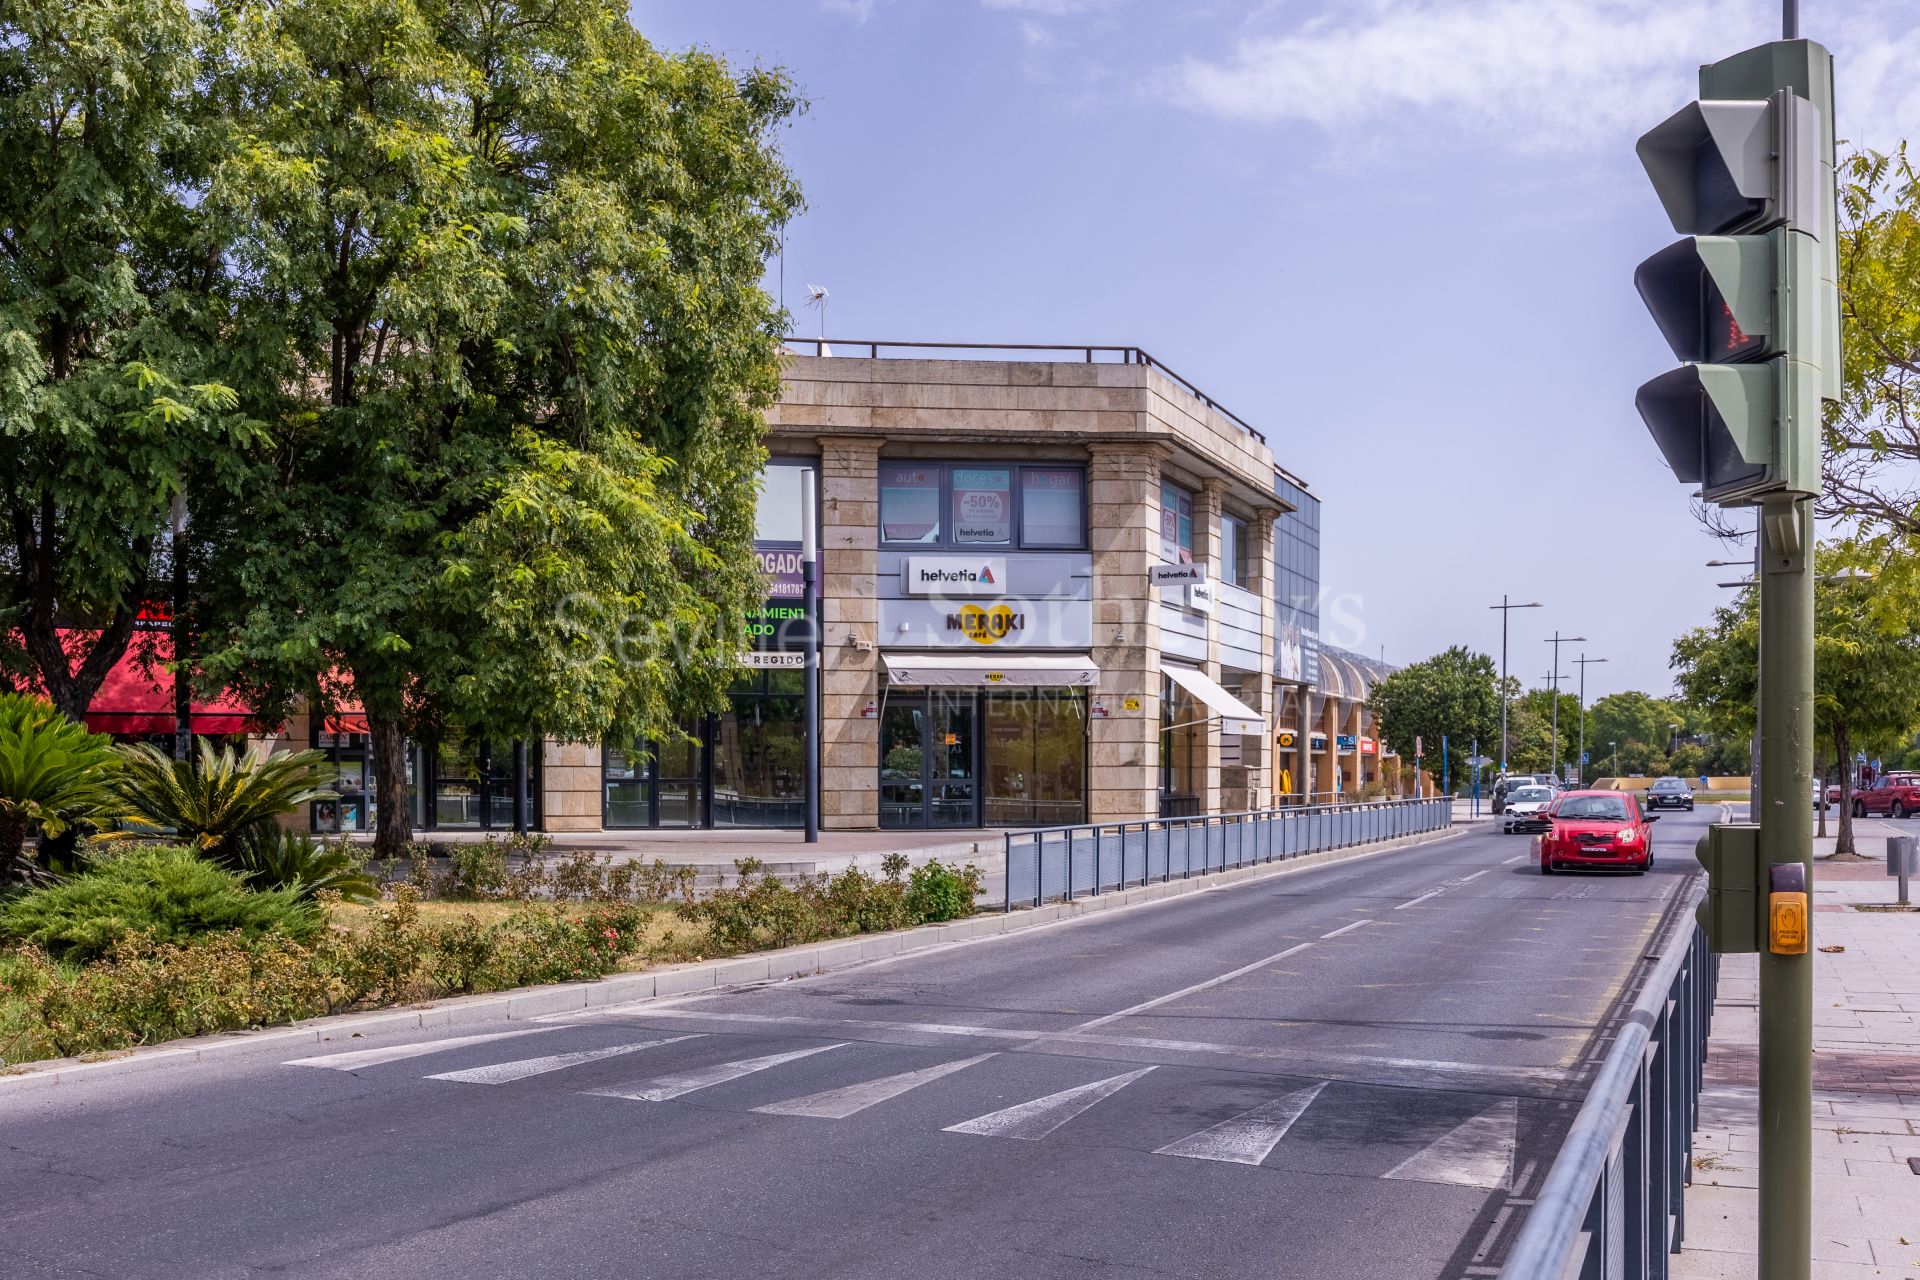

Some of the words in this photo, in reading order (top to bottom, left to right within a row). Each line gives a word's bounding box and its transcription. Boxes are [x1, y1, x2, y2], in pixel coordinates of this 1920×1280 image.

[896, 472, 926, 484] auto
[954, 471, 1009, 484] decesos
[1031, 472, 1072, 488] hogar
[963, 495, 999, 509] -50%
[959, 528, 994, 537] helvetia
[921, 569, 977, 581] helvetia
[1158, 570, 1188, 580] helvetia
[946, 613, 1025, 631] MERAKI
